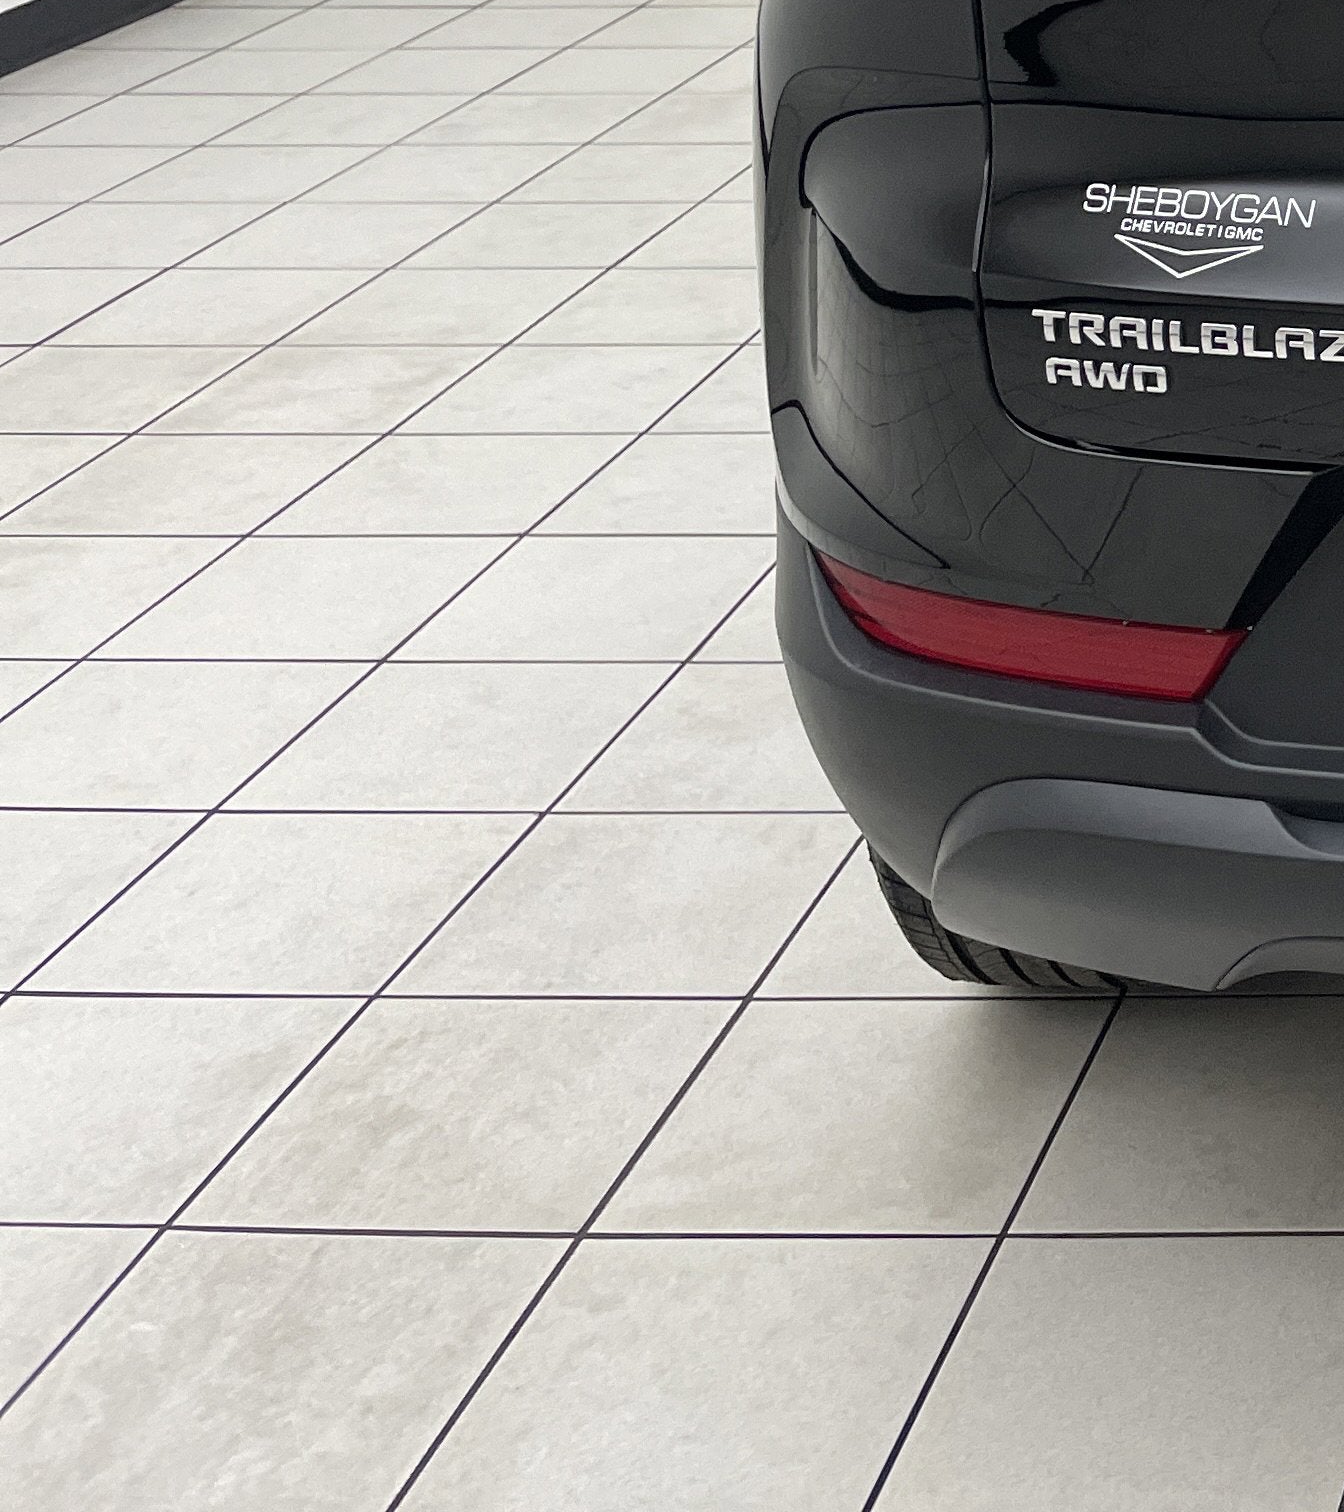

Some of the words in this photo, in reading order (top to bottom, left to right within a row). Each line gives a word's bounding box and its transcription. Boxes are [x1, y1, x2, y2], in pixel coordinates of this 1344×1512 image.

[1082, 182, 1317, 229] SHEBOYGAN
[1119, 218, 1217, 238] CHEVROLET
[1223, 227, 1264, 242] GMC
[1045, 356, 1168, 394] AWD
